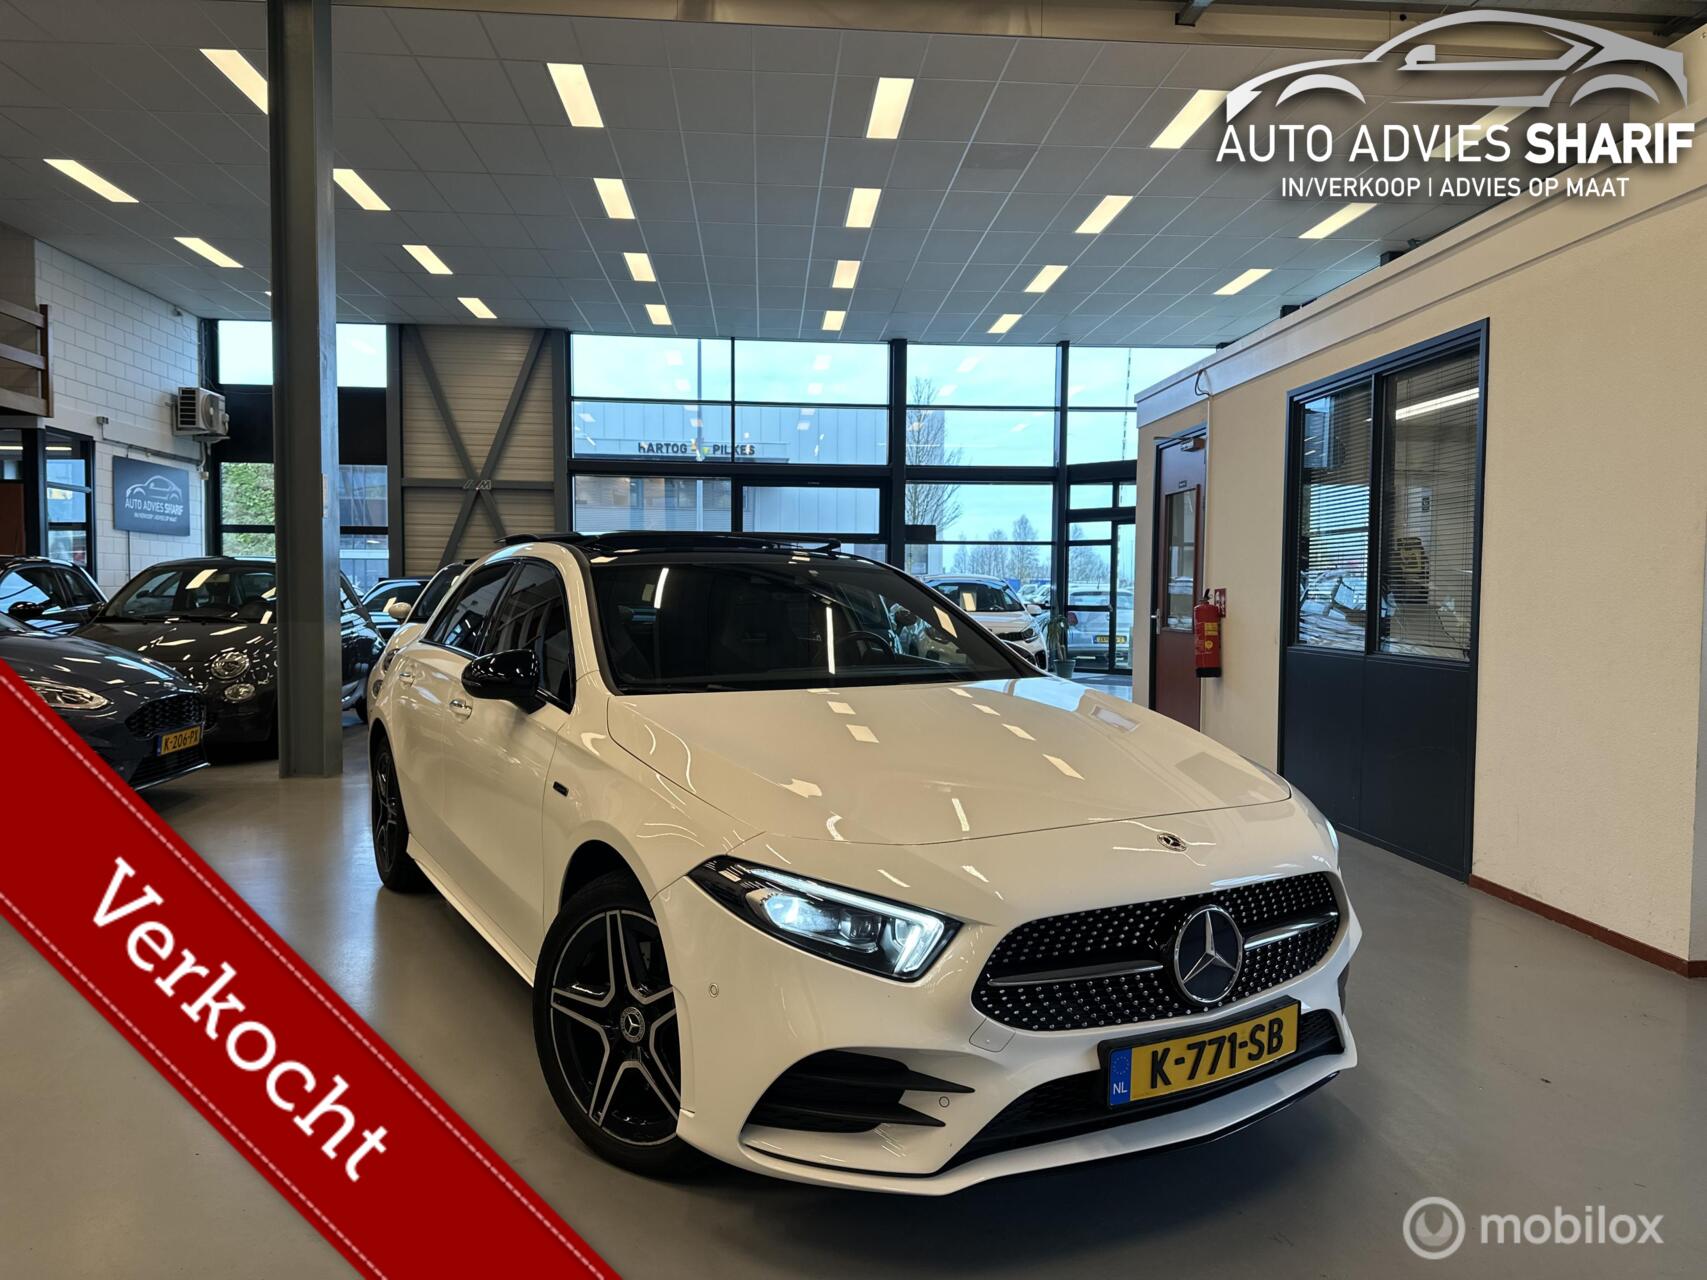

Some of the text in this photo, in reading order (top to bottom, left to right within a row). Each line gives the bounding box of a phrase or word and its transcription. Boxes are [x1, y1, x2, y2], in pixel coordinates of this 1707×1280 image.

[125, 498, 143, 510] AUTO
[1112, 1017, 1284, 1096] NL K-771-SB
